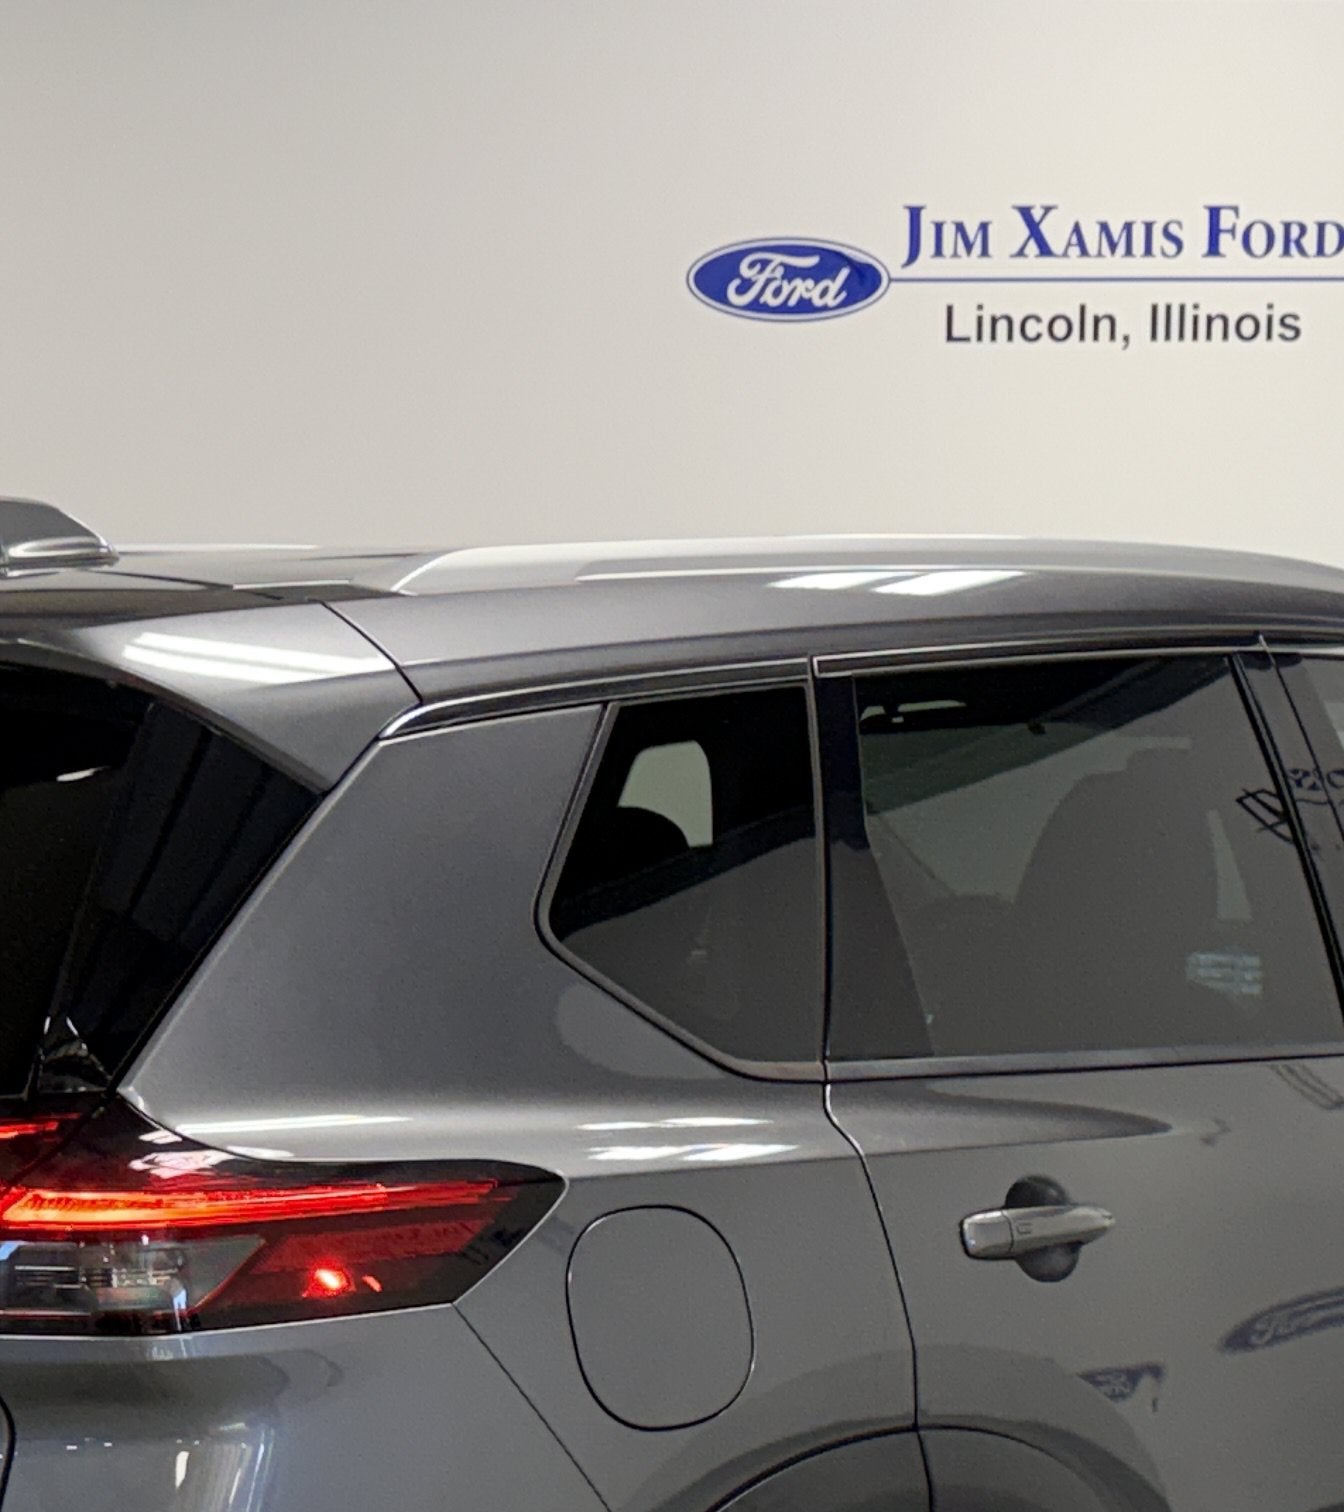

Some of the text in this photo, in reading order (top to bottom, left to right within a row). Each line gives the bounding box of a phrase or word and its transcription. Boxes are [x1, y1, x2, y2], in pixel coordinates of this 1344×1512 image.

[902, 205, 992, 269] JIM
[1010, 206, 1184, 259] XAMIS
[726, 251, 852, 308] Ford
[945, 303, 1302, 349] Lincoln, Illinois
